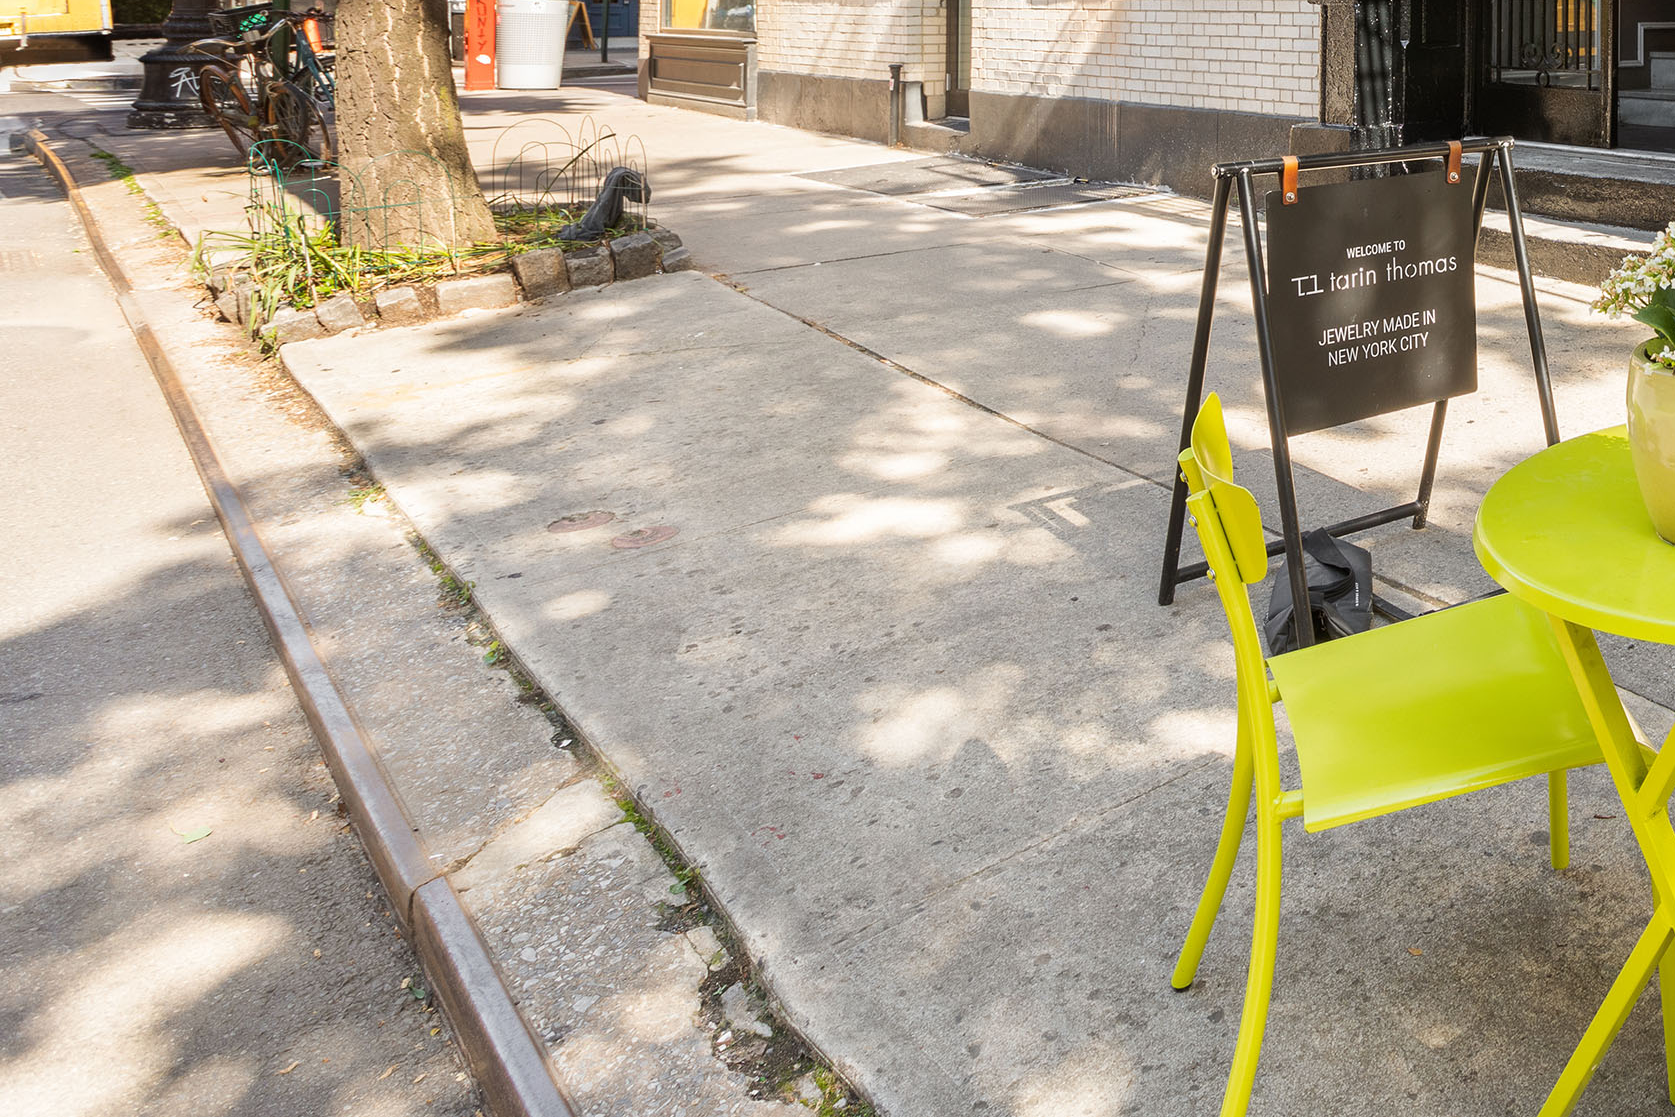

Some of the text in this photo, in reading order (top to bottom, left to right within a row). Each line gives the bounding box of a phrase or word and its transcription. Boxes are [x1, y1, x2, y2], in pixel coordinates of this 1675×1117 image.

[1346, 239, 1406, 259] WELCOME TO
[1330, 267, 1377, 292] tarin
[1386, 256, 1458, 282] thomas
[1318, 309, 1436, 346] JEWELRY MADE IN
[1328, 331, 1429, 367] NEW YORK CITY
